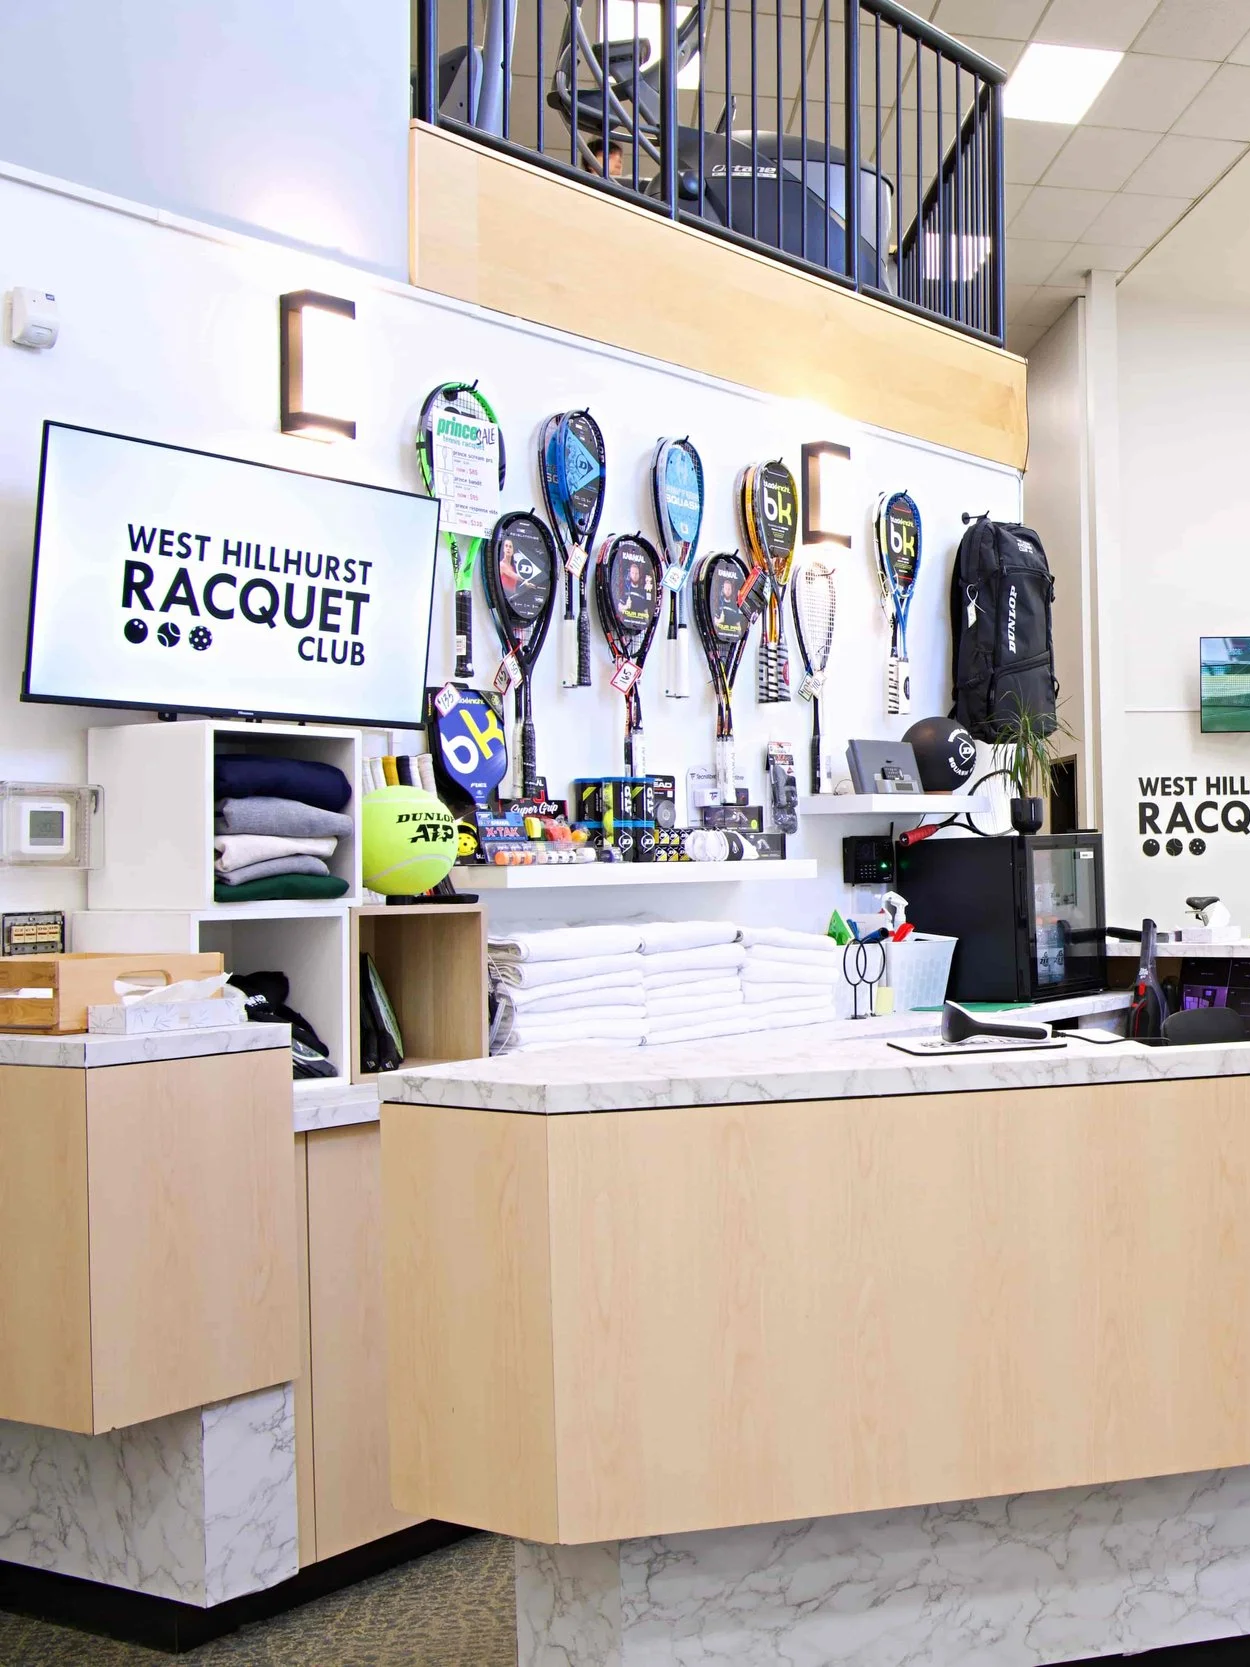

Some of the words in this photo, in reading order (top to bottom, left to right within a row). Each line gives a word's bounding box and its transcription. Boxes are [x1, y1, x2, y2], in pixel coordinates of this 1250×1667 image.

[436, 417, 478, 441] prince
[476, 428, 495, 446] SALE
[764, 486, 792, 526] bk
[127, 523, 211, 562] WEST
[222, 539, 373, 585] HILLHURST
[890, 523, 915, 557] bk
[121, 559, 370, 636] RACQUET
[1007, 585, 1017, 654] DUNLOP
[298, 636, 365, 666] CLUB
[440, 709, 505, 774] bk
[1138, 776, 1197, 796] WEST
[539, 801, 559, 816] Grip
[408, 824, 454, 844] ATP
